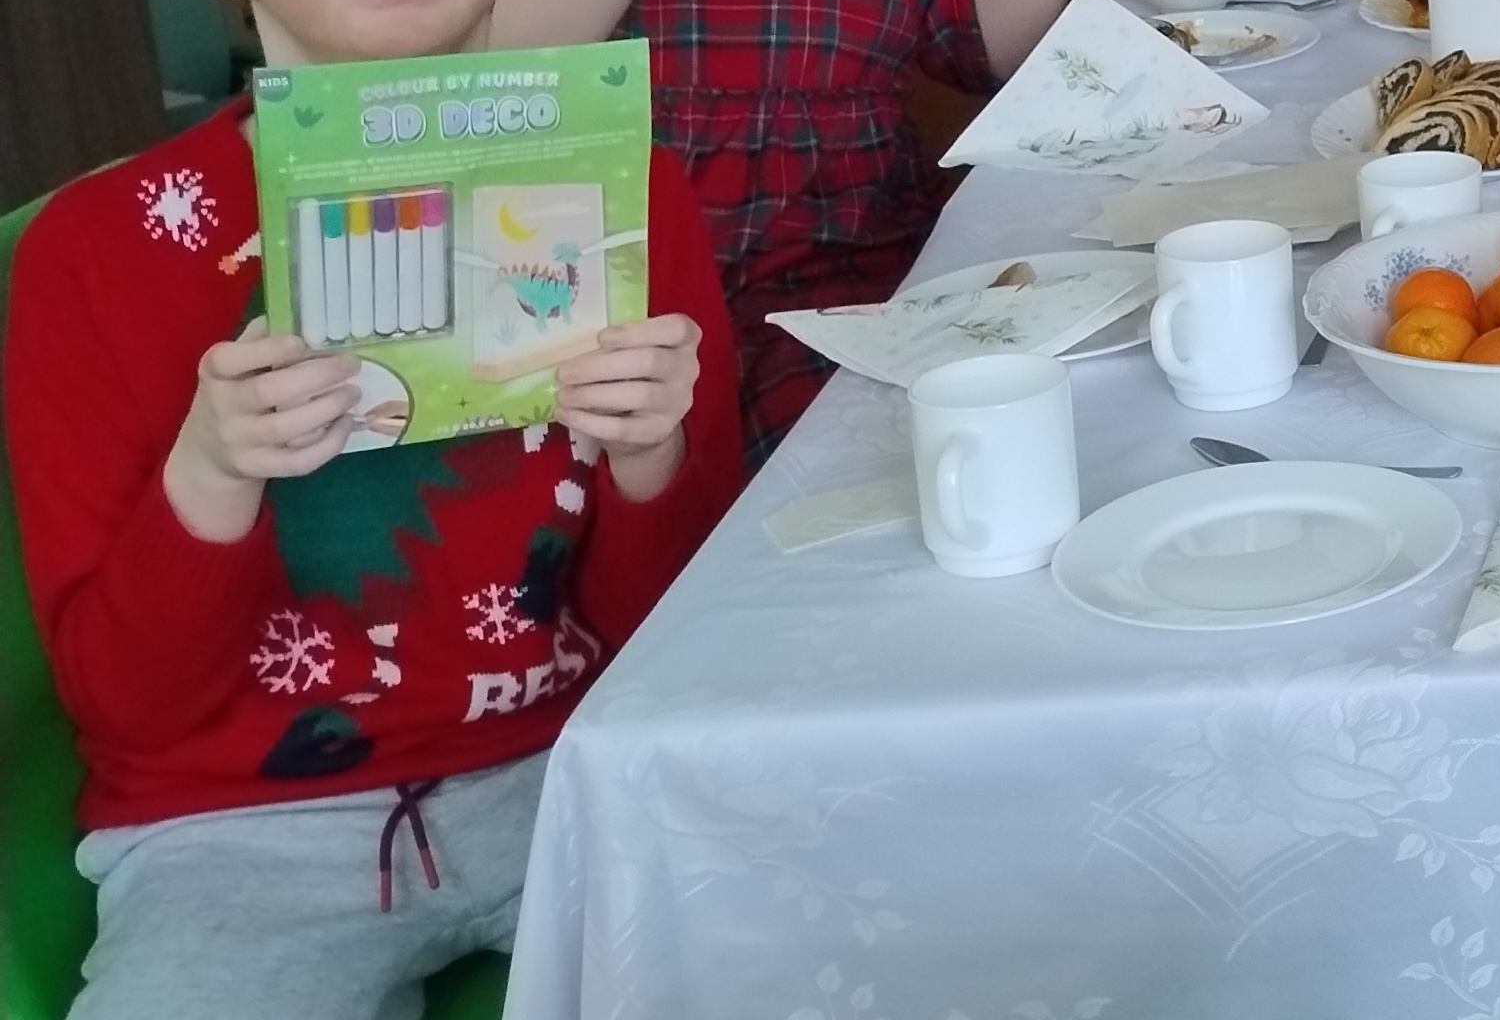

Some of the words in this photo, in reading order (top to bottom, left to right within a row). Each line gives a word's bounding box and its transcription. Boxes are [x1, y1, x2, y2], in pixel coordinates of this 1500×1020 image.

[258, 76, 290, 89] KIDS
[359, 76, 441, 103] COLOUR
[446, 73, 472, 91] BY
[478, 71, 560, 89] NUMBER
[362, 103, 427, 148] 3D
[439, 93, 562, 141] DECO
